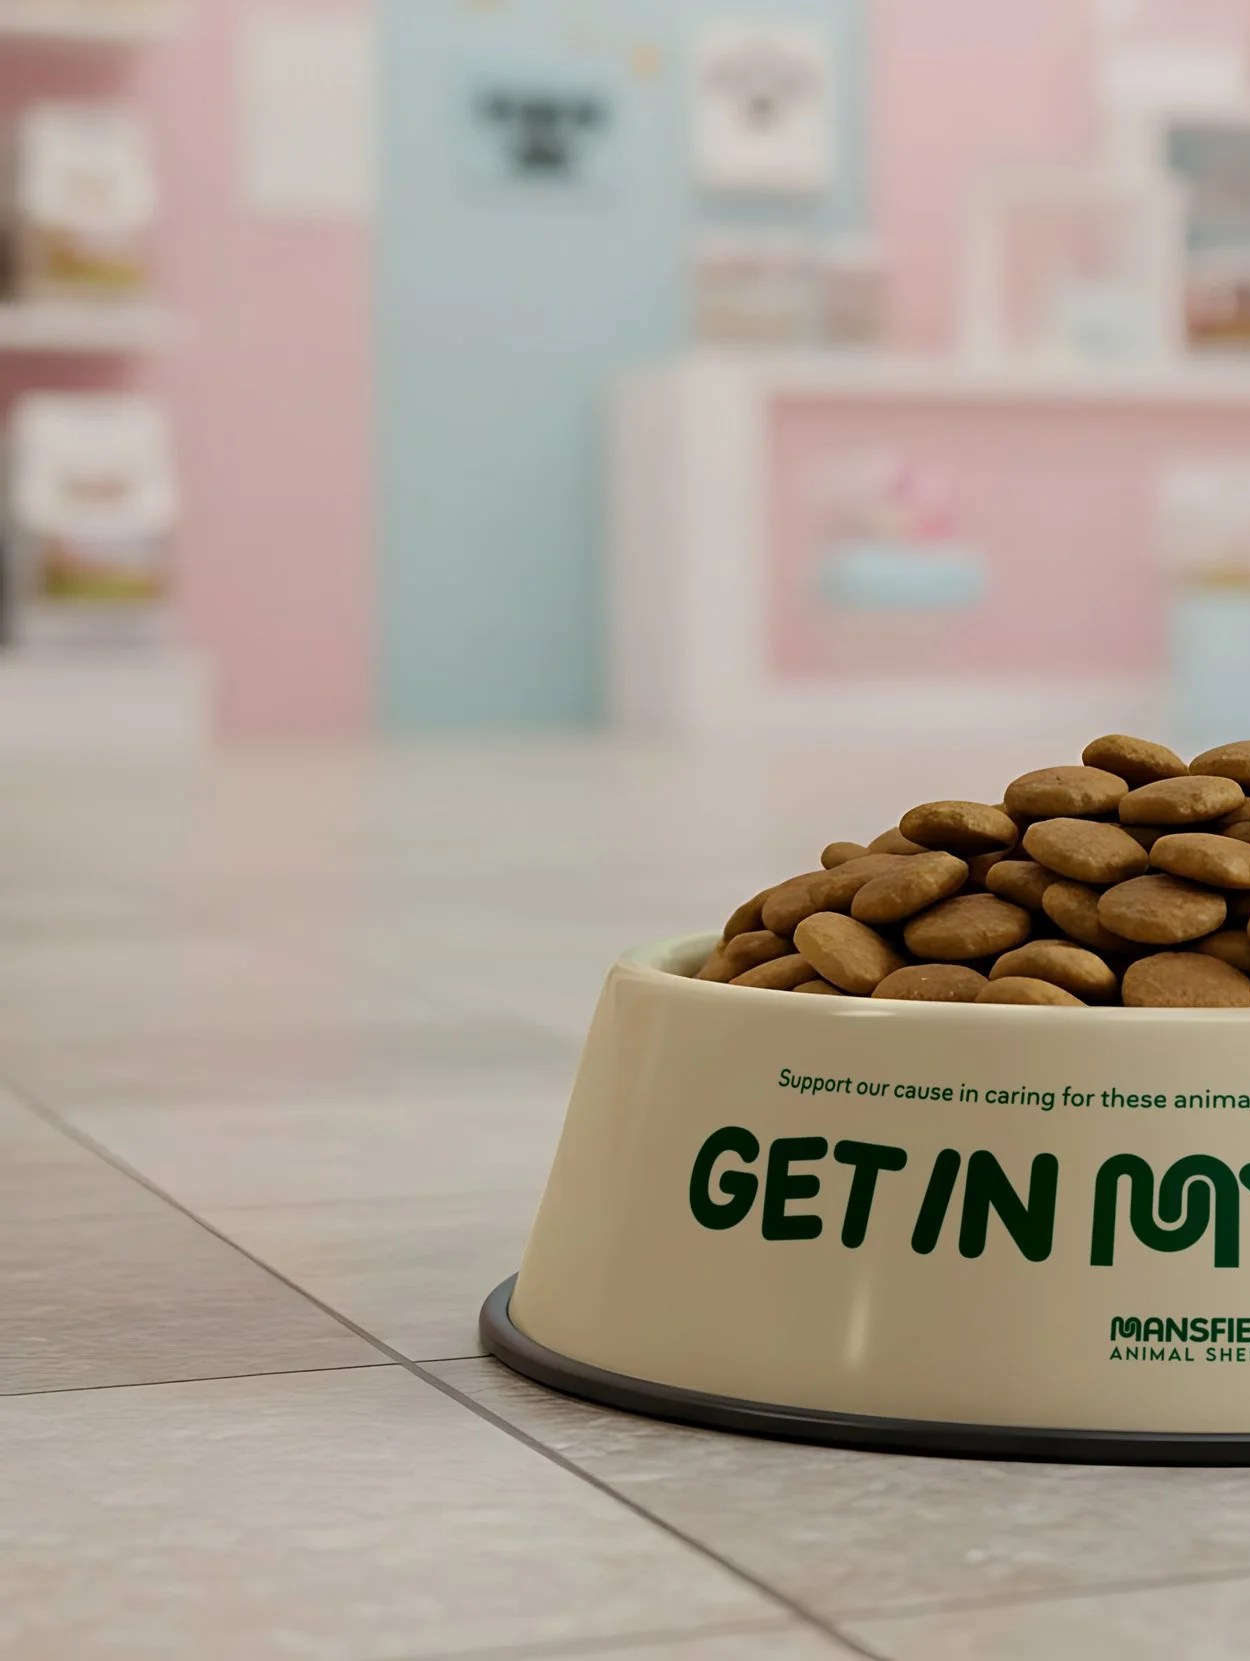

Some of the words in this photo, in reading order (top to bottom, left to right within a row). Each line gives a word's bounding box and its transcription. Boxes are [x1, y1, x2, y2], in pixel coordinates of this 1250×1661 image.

[778, 1068, 852, 1096] Support
[856, 1080, 889, 1097] our
[894, 1083, 953, 1102] cause
[959, 1083, 979, 1103] in
[984, 1086, 1056, 1111] caring
[1062, 1086, 1096, 1108] for
[1101, 1087, 1168, 1109] these
[688, 1126, 908, 1250] GET
[911, 1147, 1059, 1263] IN
[1109, 1346, 1195, 1361] ANIMAL
